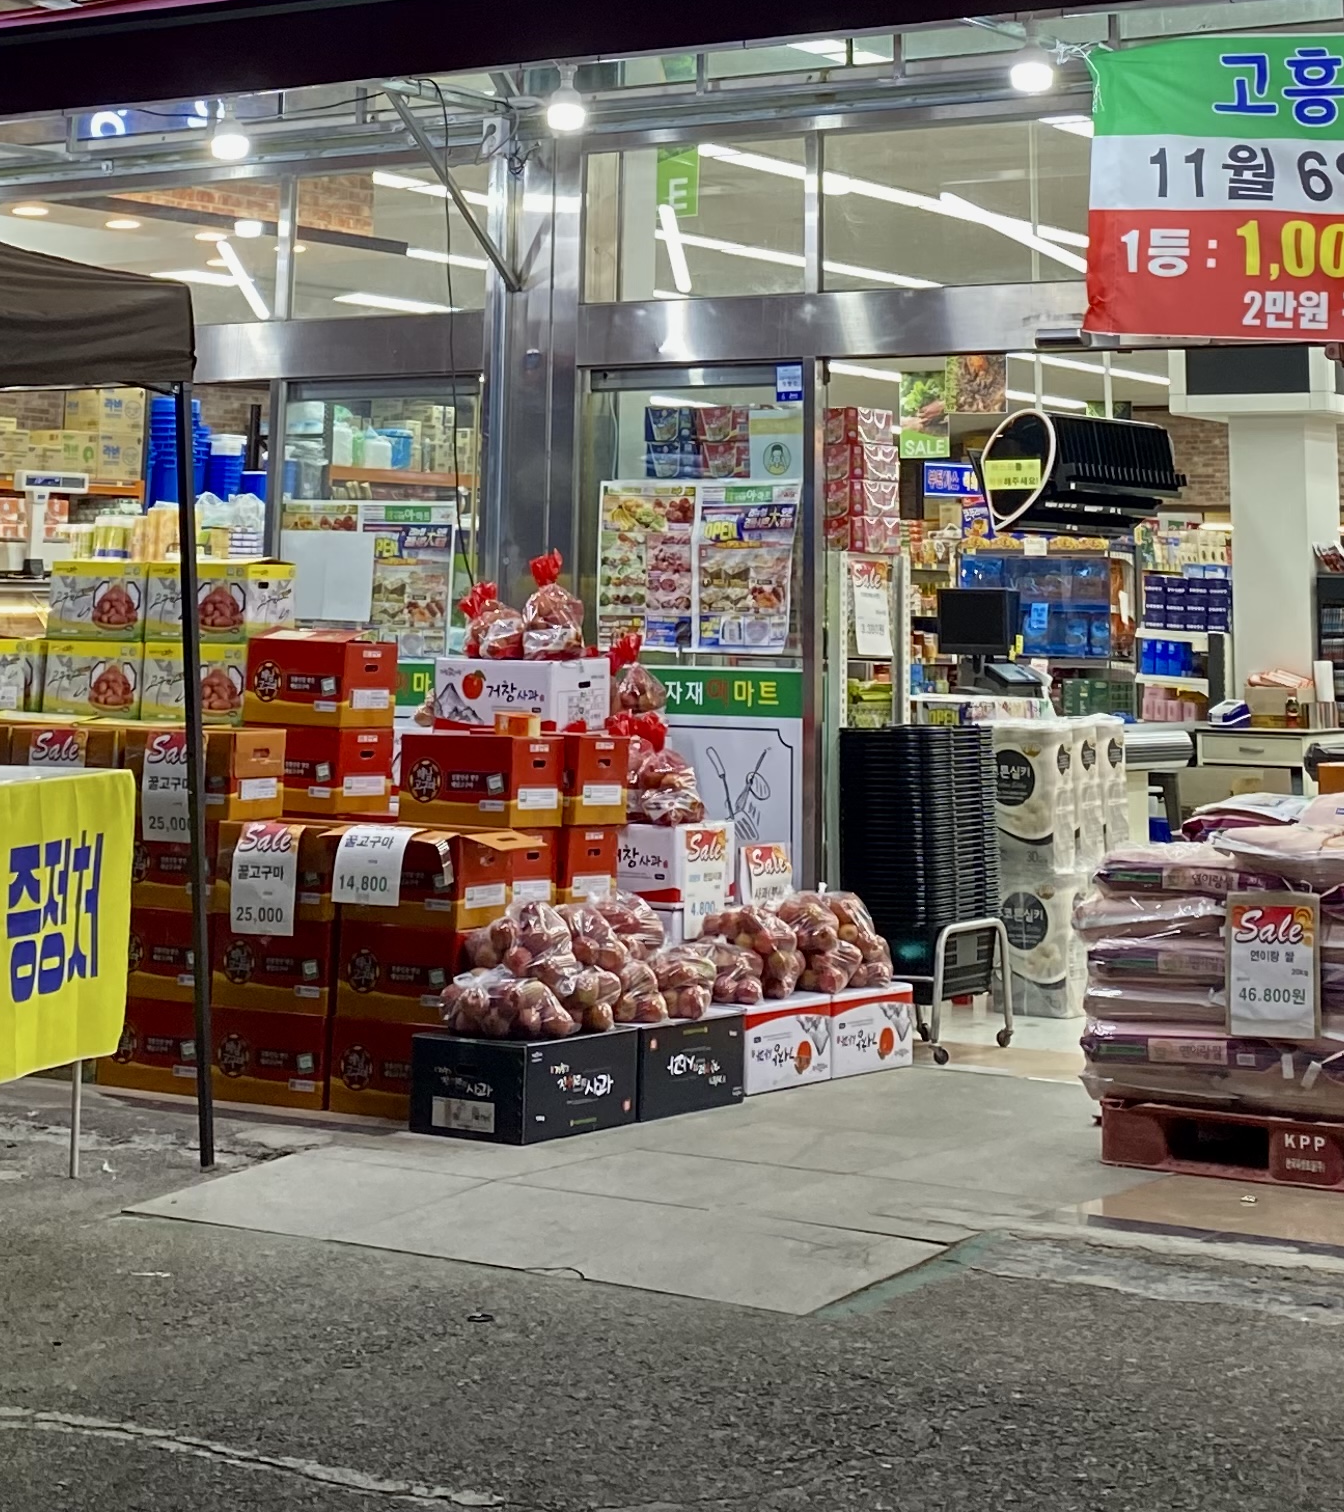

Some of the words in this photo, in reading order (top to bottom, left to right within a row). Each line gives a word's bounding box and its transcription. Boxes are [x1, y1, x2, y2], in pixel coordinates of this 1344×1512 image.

[1149, 146, 1274, 202] 11월
[1242, 291, 1328, 330] 2만원
[905, 439, 945, 455] SALE
[375, 538, 400, 558] PEN
[854, 563, 882, 589] Sale
[31, 729, 79, 762] Sale
[147, 734, 189, 766] Sal
[993, 765, 1031, 780] 튼실키
[238, 823, 291, 852] Sale
[344, 834, 395, 850] 꿀고구마
[687, 831, 723, 863] Sale
[237, 864, 284, 881] 꿀고구마
[753, 848, 787, 876] Sale
[5, 829, 105, 1006] 증정처
[236, 906, 283, 924] 25,000
[1235, 908, 1304, 944] Sale
[1250, 950, 1280, 963] 연이랑
[1238, 987, 1306, 1005] 46.800원
[1284, 1133, 1325, 1152] KPP
